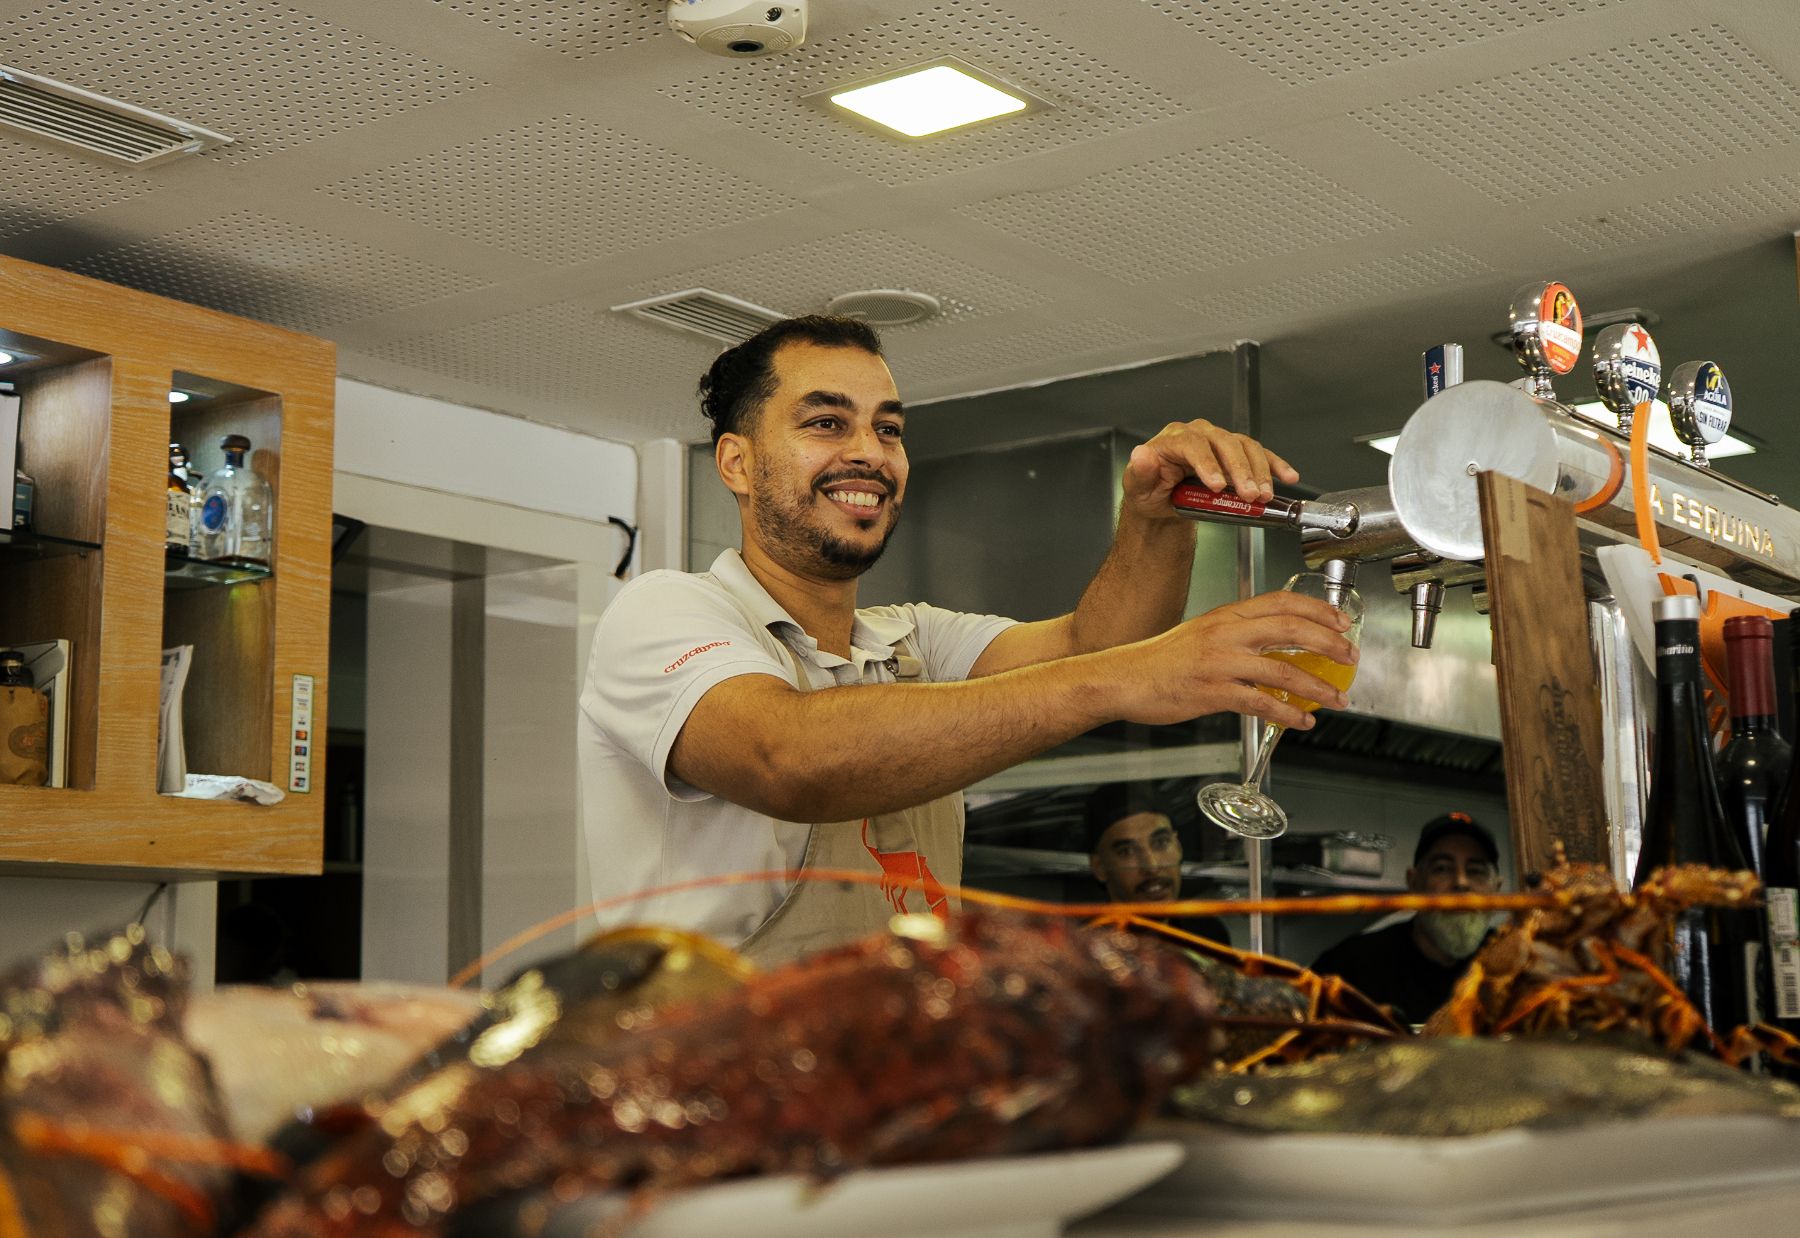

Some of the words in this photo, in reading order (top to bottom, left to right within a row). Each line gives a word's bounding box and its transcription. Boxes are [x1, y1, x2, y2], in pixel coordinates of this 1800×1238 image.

[1622, 361, 1661, 388] eineke
[1212, 498, 1252, 513] Cruzcampo
[1672, 492, 1774, 557] ESQUINA
